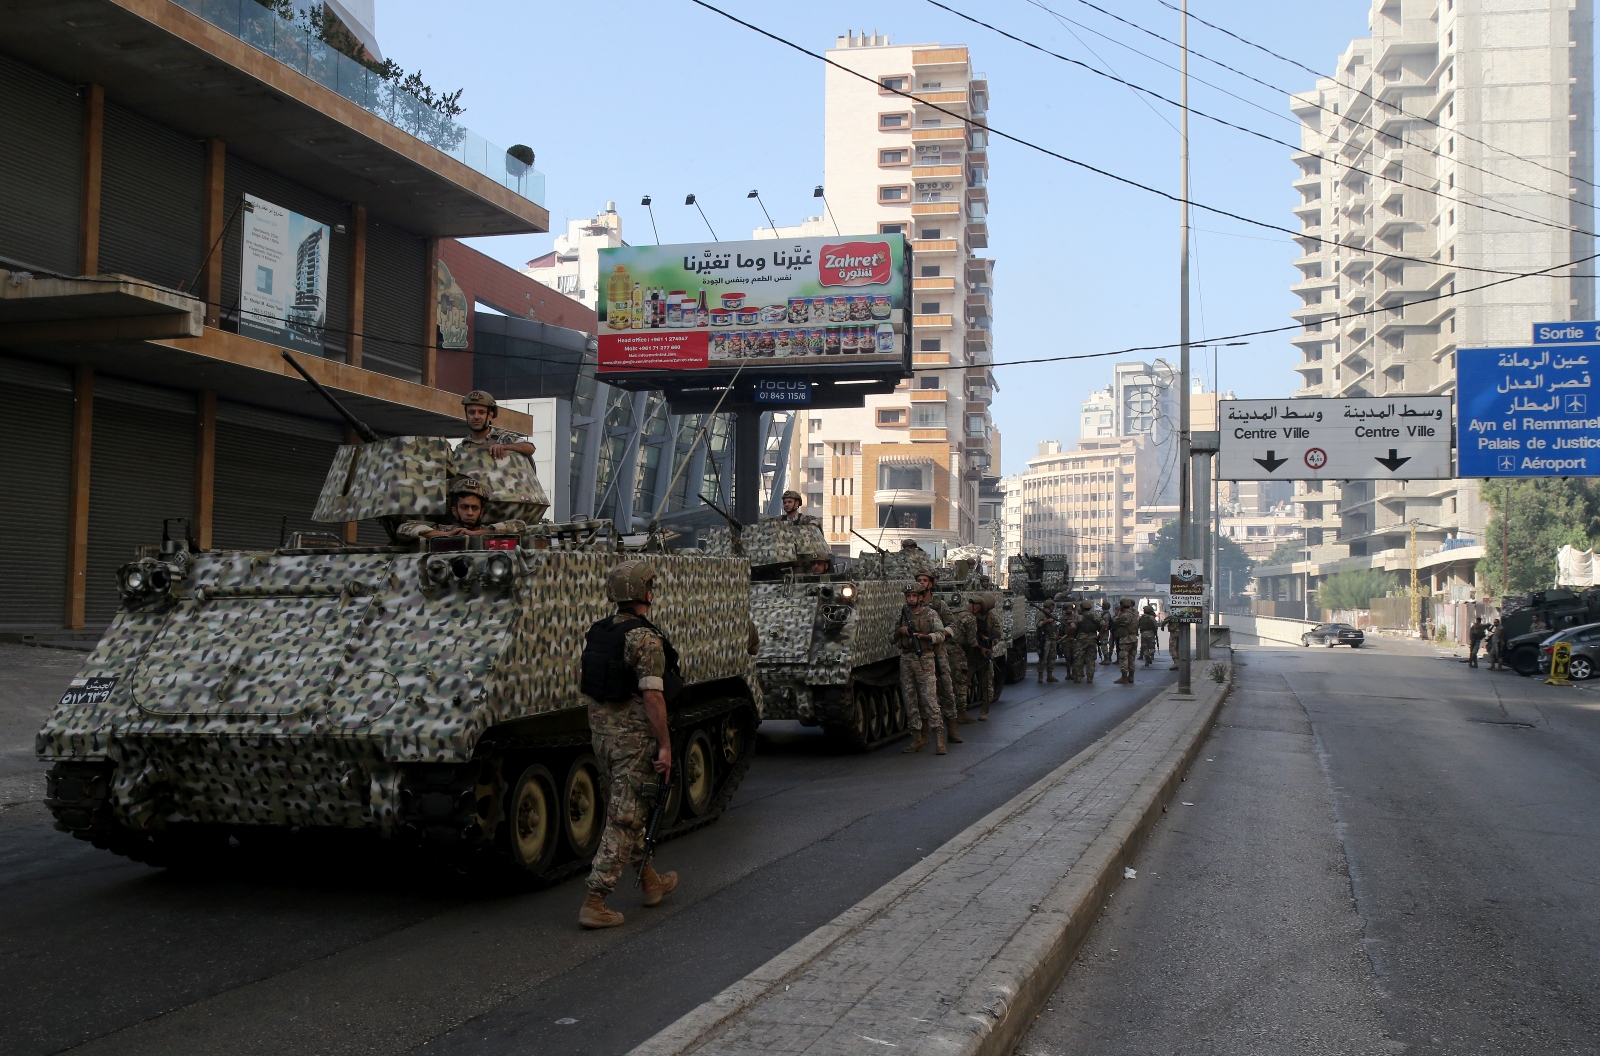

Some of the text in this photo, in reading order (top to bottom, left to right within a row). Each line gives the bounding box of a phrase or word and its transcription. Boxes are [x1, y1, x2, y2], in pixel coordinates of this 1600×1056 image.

[737, 253, 766, 271] وما
[824, 254, 878, 270] Zahret
[702, 277, 722, 286] الجودة
[750, 275, 772, 285] الطعم
[774, 275, 792, 283] نفس
[838, 269, 873, 282] شتورة
[1539, 327, 1584, 340] Sortie
[1498, 351, 1589, 369] عين الرمانة
[760, 380, 807, 390] focus
[1497, 371, 1591, 393] قصر العدل
[759, 392, 768, 400] 01
[1505, 395, 1560, 414] المطار
[1228, 406, 1323, 423] وسط المدينة
[1343, 404, 1443, 421] وسط المدينة
[1234, 427, 1310, 439] Centre Ville
[1355, 425, 1435, 438] Centre Ville
[1469, 419, 1496, 434] Ayn
[1503, 419, 1516, 430] el
[1478, 437, 1521, 450] Palais
[1526, 437, 1546, 449] de
[1521, 457, 1586, 471] Aéroport
[86, 680, 114, 690] الجيش
